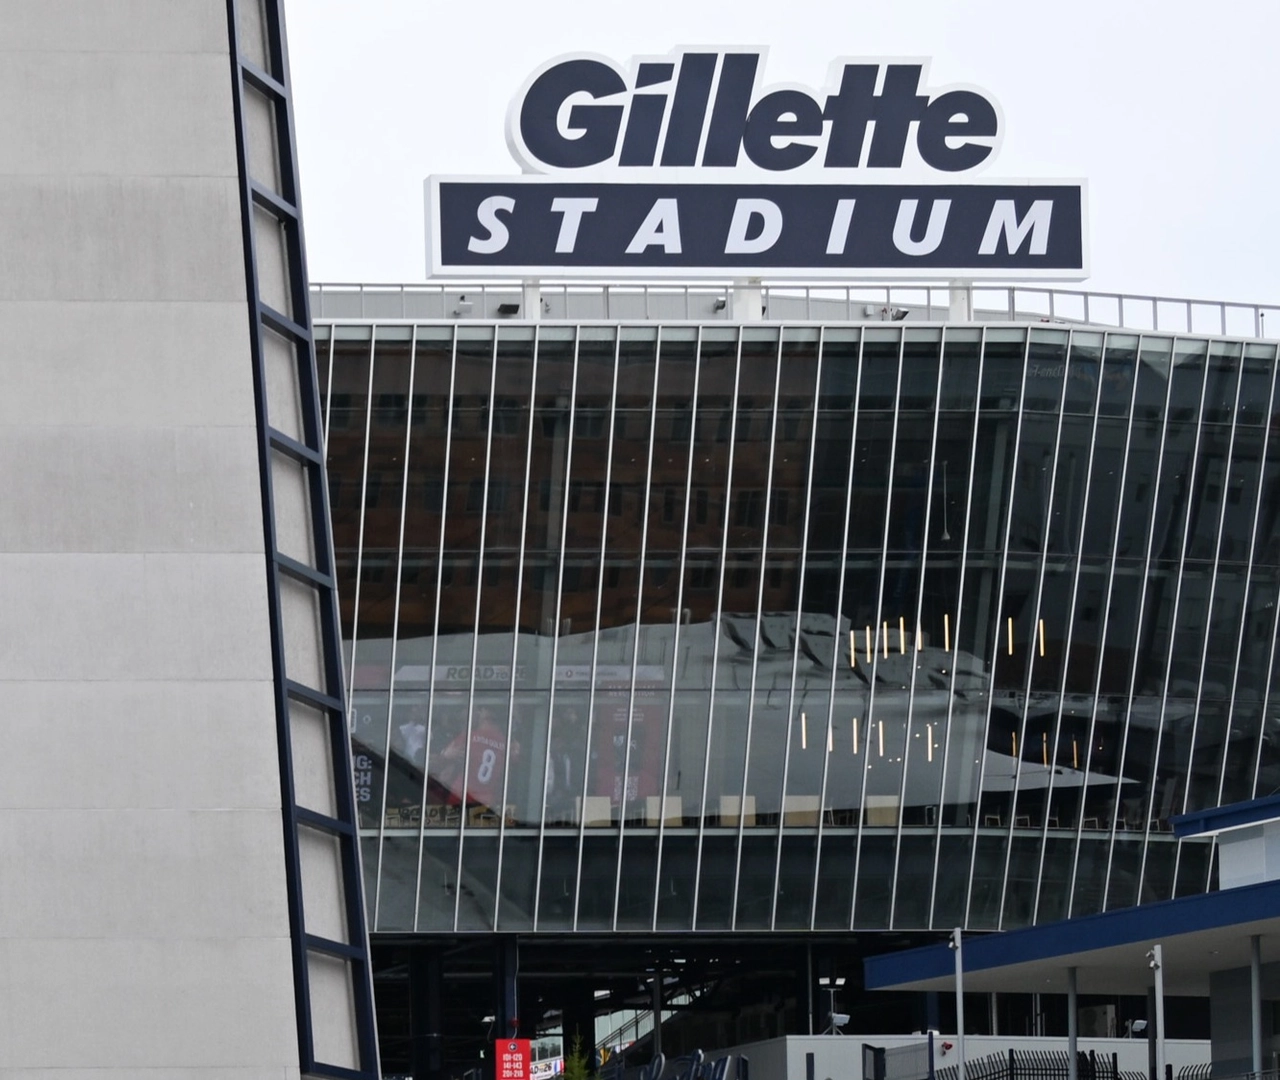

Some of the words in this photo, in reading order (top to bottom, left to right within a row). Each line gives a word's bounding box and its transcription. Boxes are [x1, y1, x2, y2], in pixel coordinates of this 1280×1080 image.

[519, 52, 997, 171] Gillette
[467, 196, 1053, 256] STADIUM
[477, 749, 496, 783] 8
